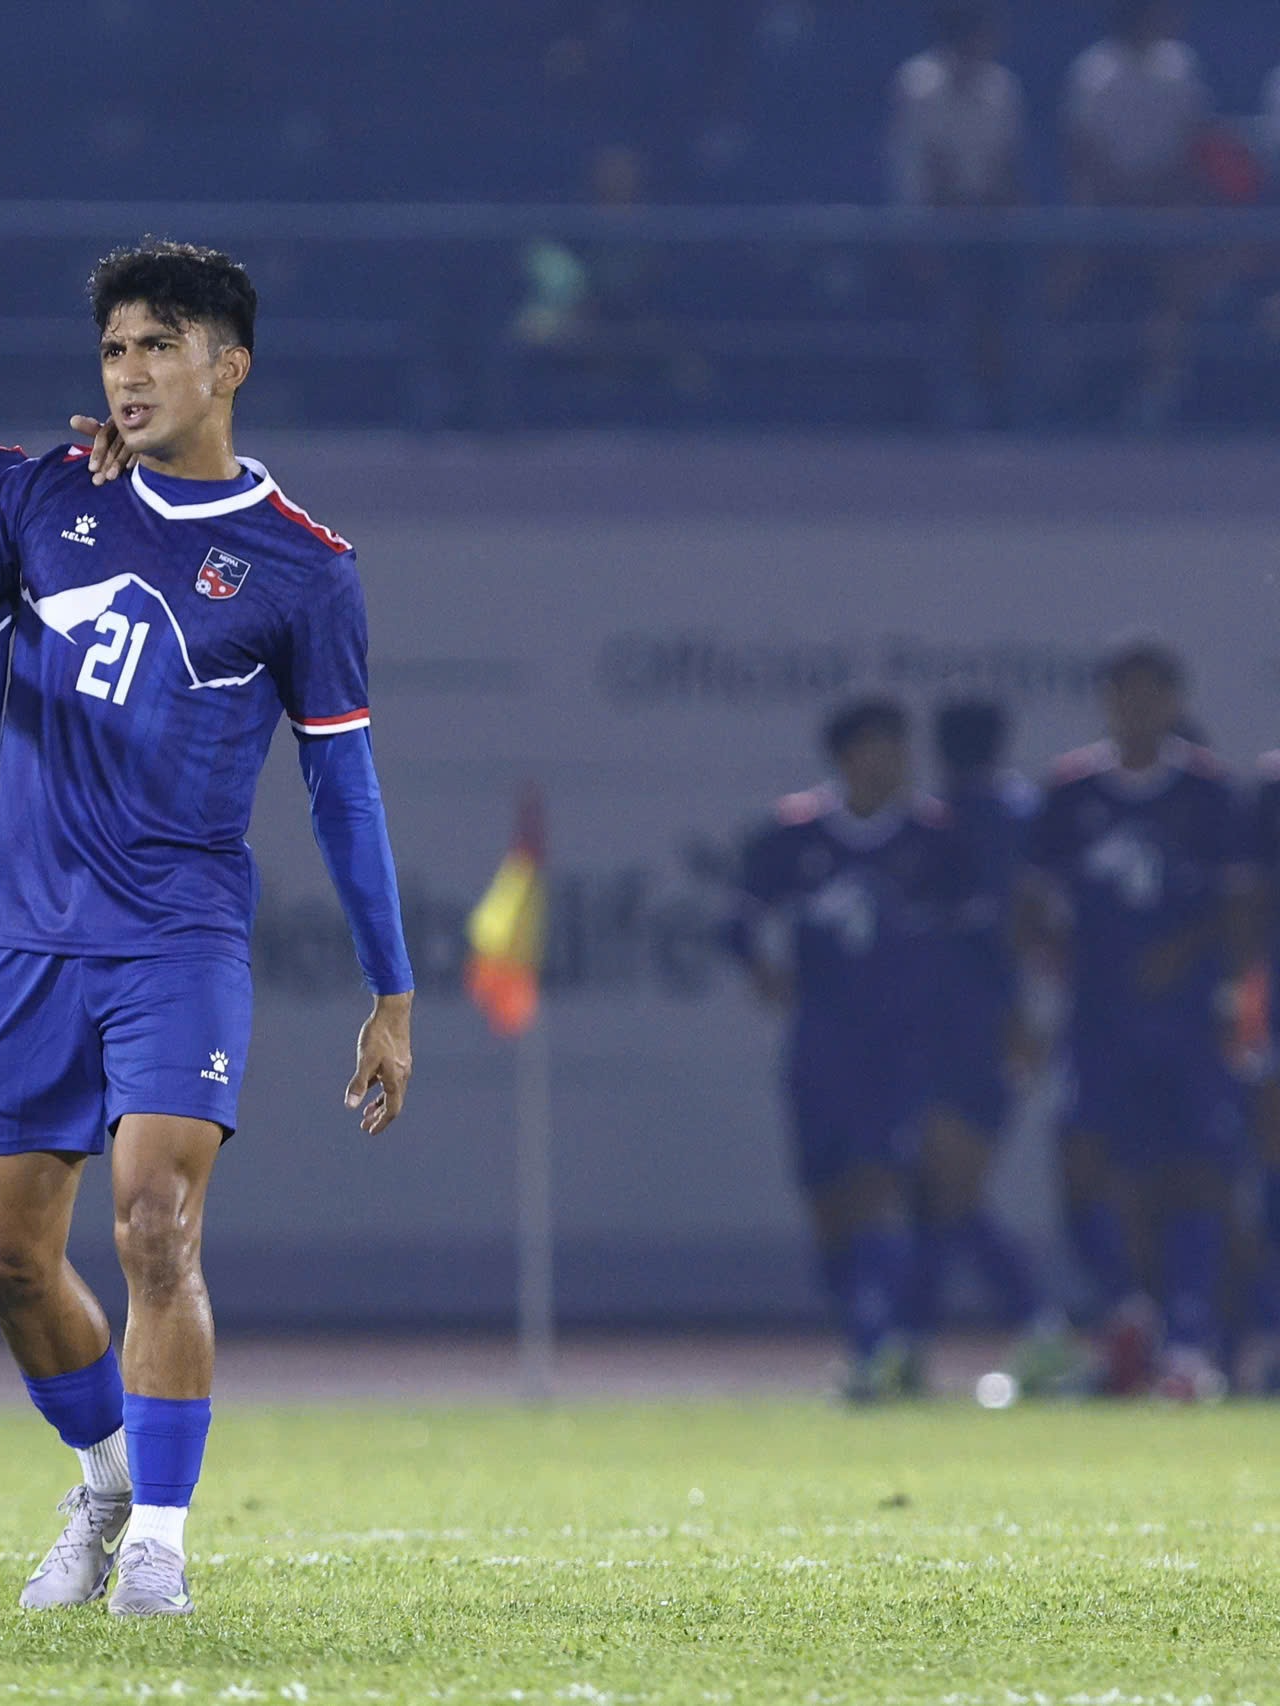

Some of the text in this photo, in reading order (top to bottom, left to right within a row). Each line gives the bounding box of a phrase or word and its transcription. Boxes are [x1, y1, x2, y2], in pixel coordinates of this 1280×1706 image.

[61, 529, 96, 547] KELME
[75, 609, 151, 706] 21
[201, 1069, 229, 1085] KELME
